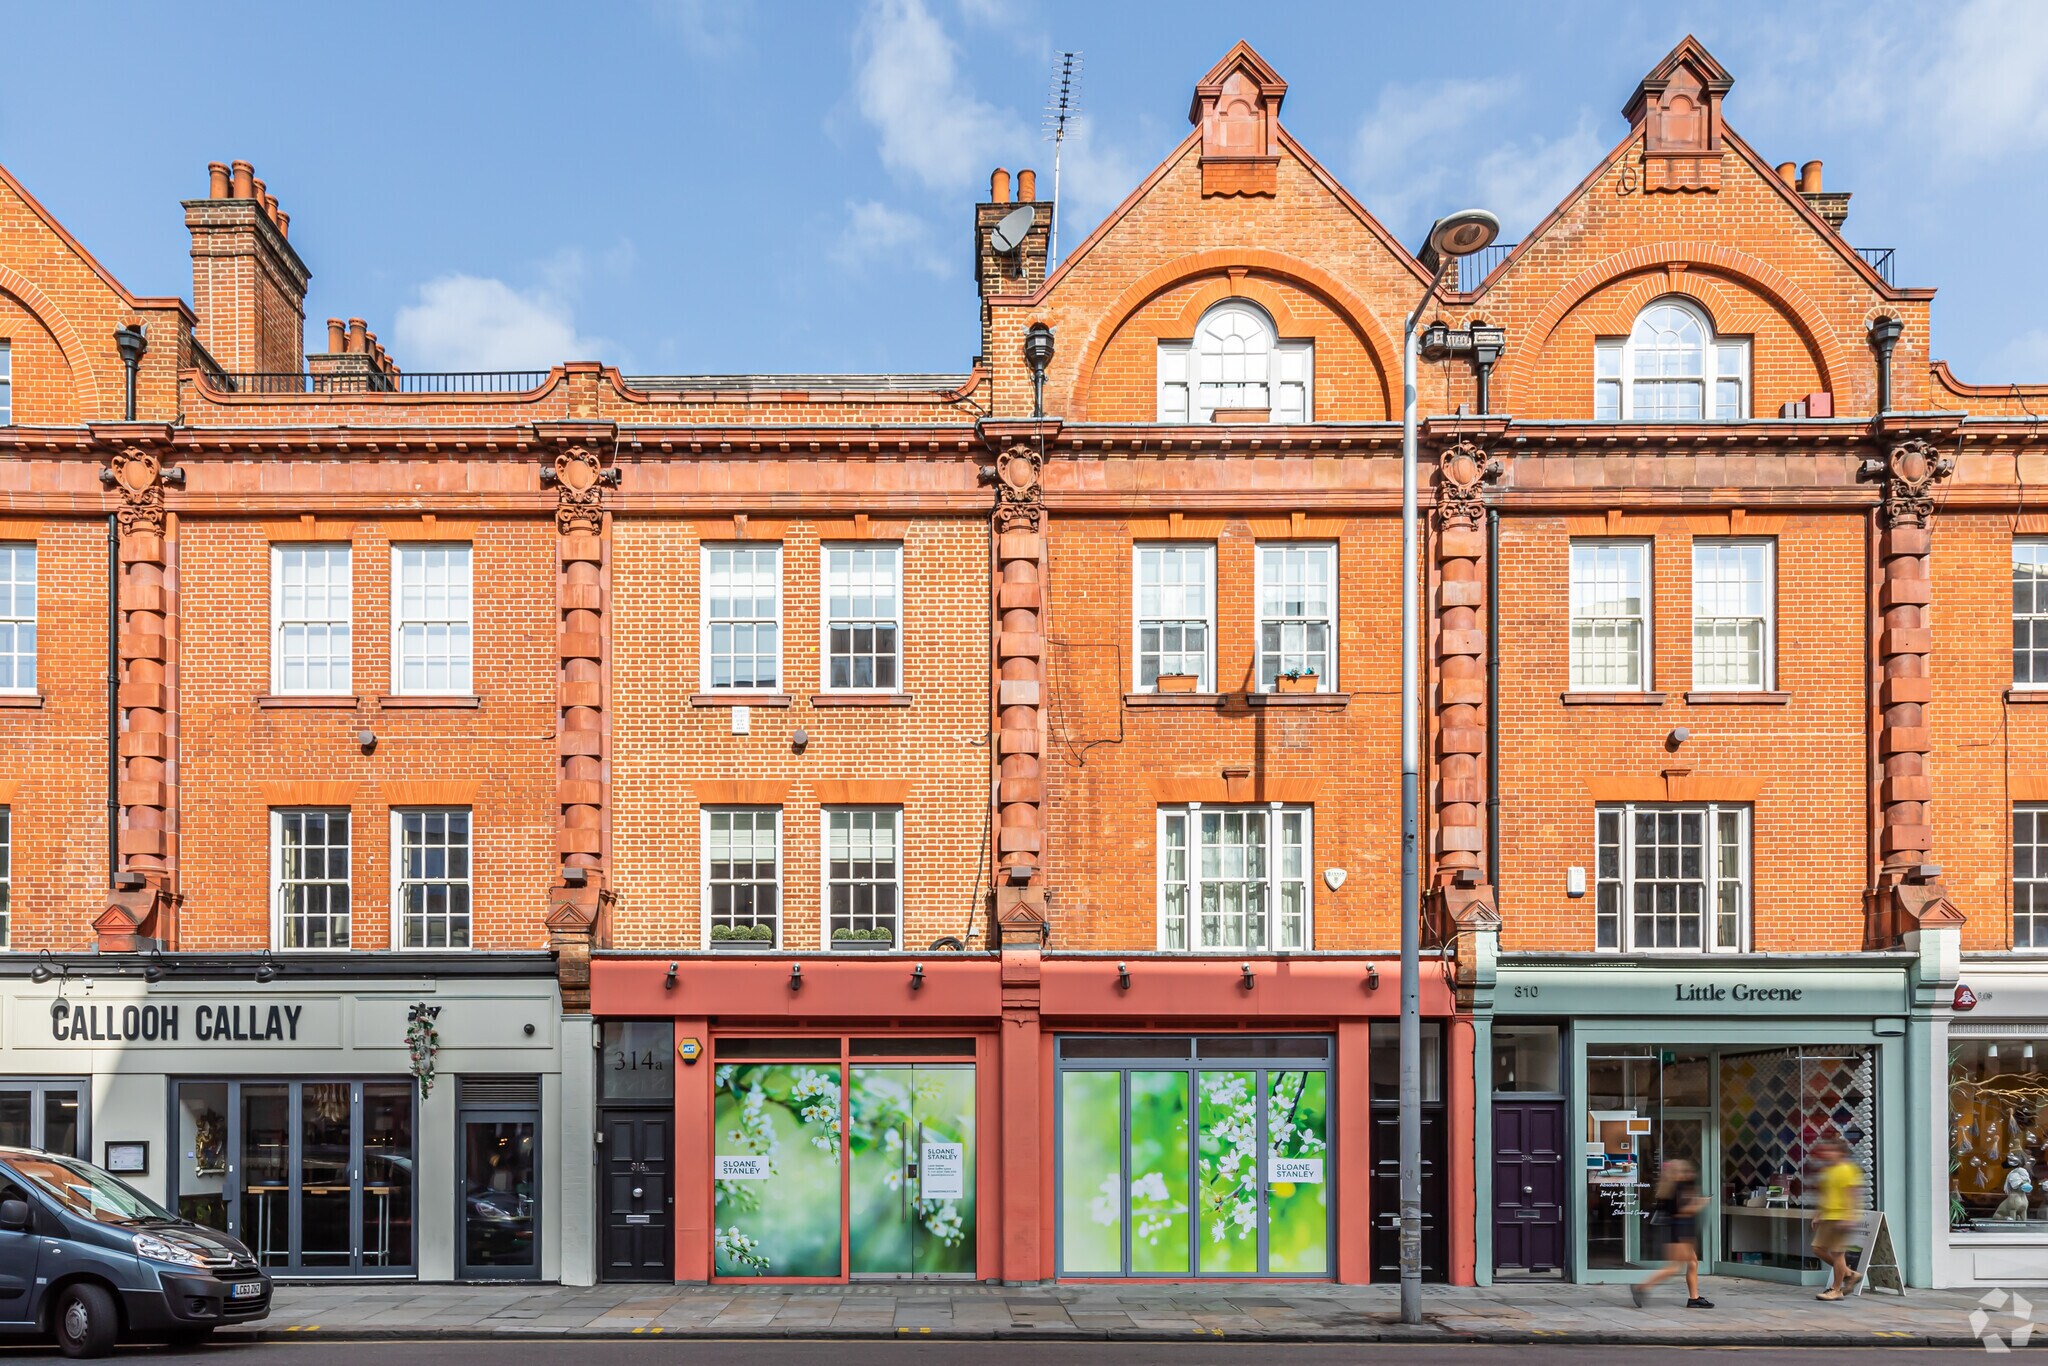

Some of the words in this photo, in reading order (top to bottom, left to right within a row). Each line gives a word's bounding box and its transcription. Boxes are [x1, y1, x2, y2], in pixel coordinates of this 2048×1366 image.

[1514, 985, 1539, 998] 310
[1675, 983, 1726, 1001] Little
[1731, 983, 1802, 1001] Greene
[52, 1005, 179, 1041] CALLOOH
[195, 1005, 303, 1041] CALLAY
[614, 1050, 663, 1071] 314a
[236, 1284, 250, 1295] LC63
